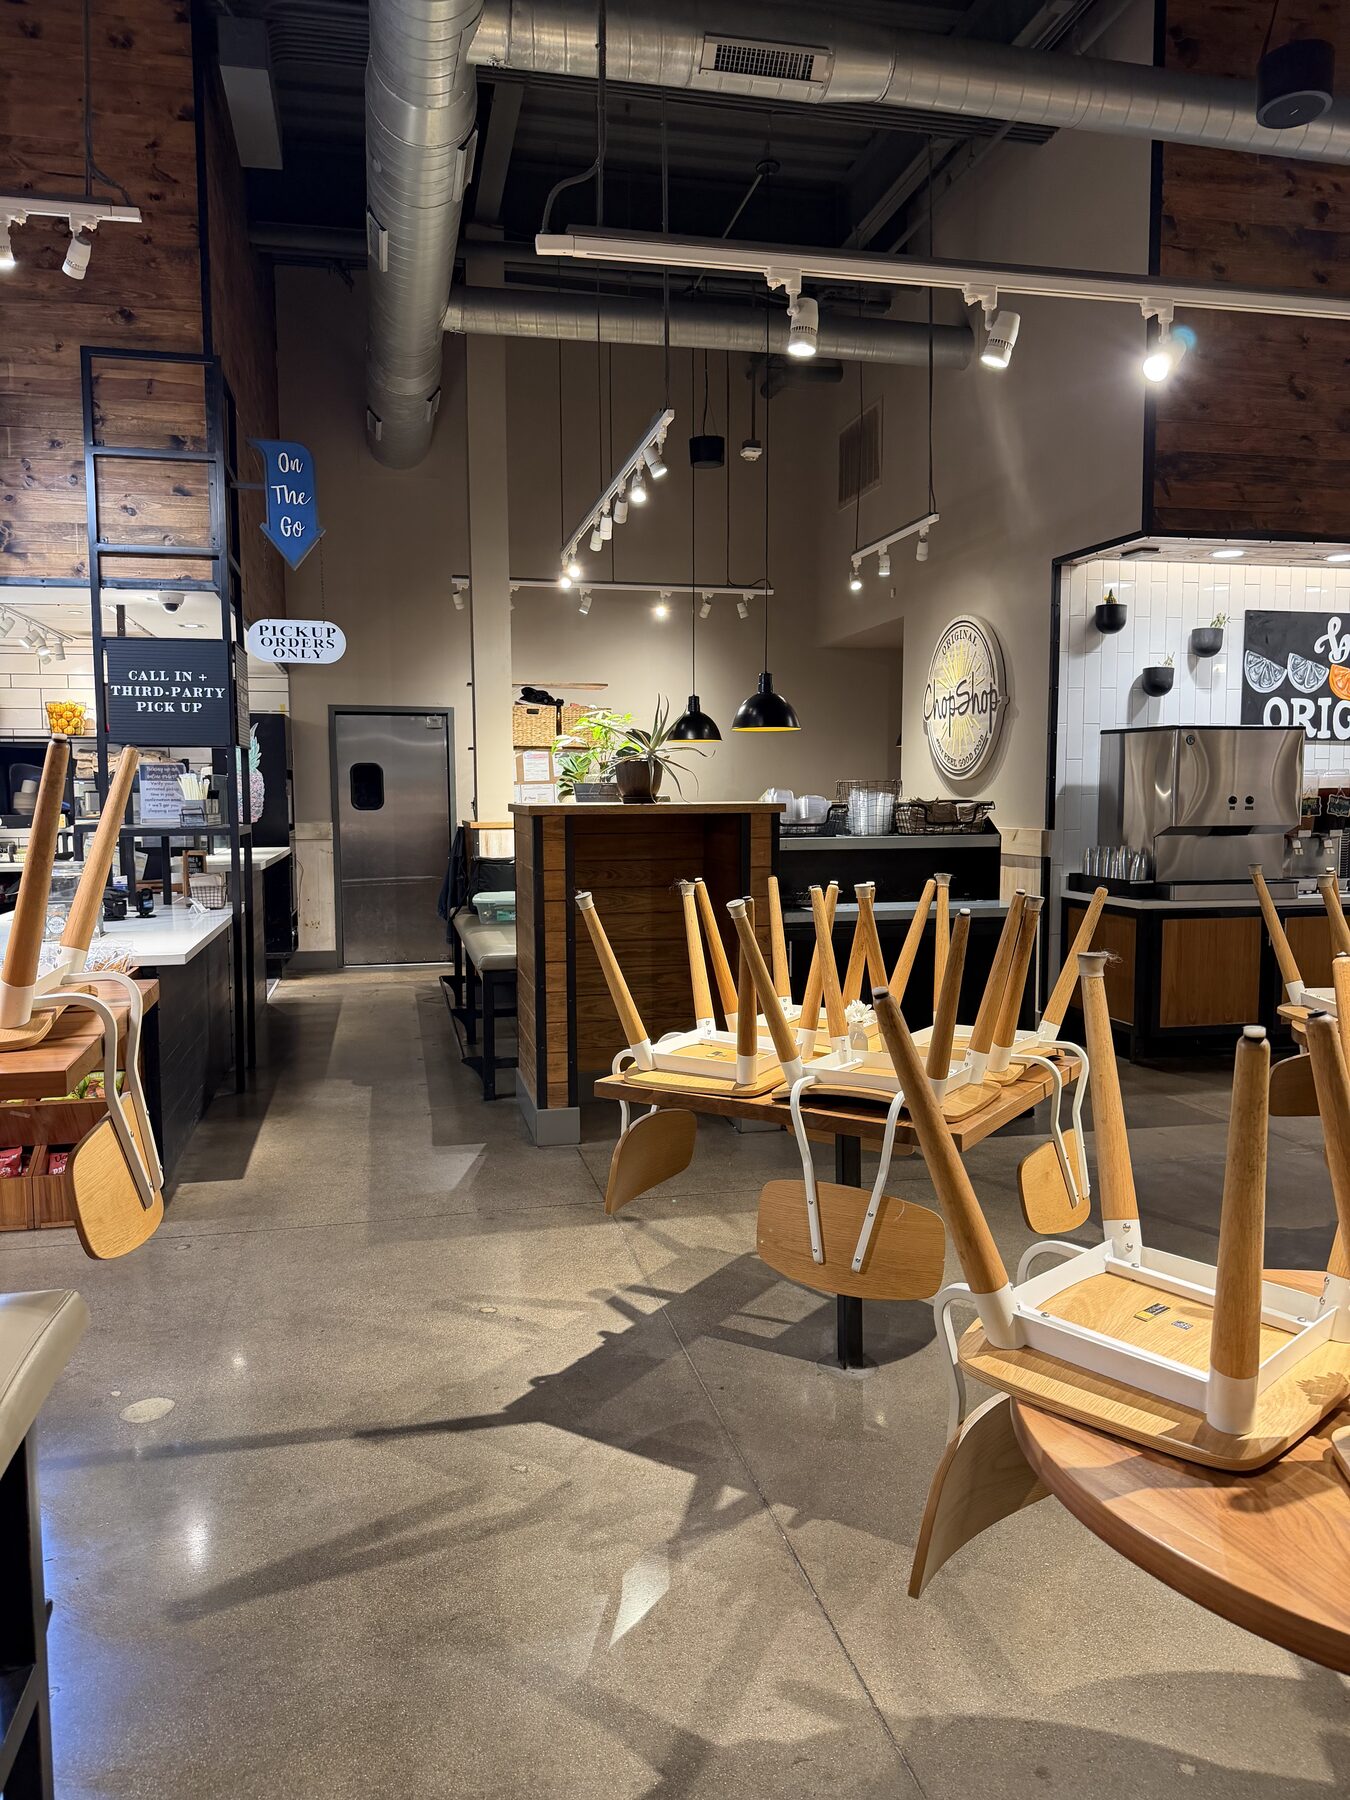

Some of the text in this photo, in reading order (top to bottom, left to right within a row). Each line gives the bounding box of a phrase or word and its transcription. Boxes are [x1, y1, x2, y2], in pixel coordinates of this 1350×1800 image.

[278, 452, 304, 473] On
[271, 484, 312, 505] The
[280, 516, 306, 538] Go
[258, 625, 337, 639] PICKUP
[260, 637, 336, 649] ORDERS
[941, 629, 978, 656] ORIGINAL
[272, 648, 324, 659] ONLY
[128, 670, 208, 682] CALL IN +
[110, 685, 226, 698] THIRD-PARTY
[136, 702, 203, 713] PICK UP
[923, 671, 1001, 738] ChopShop
